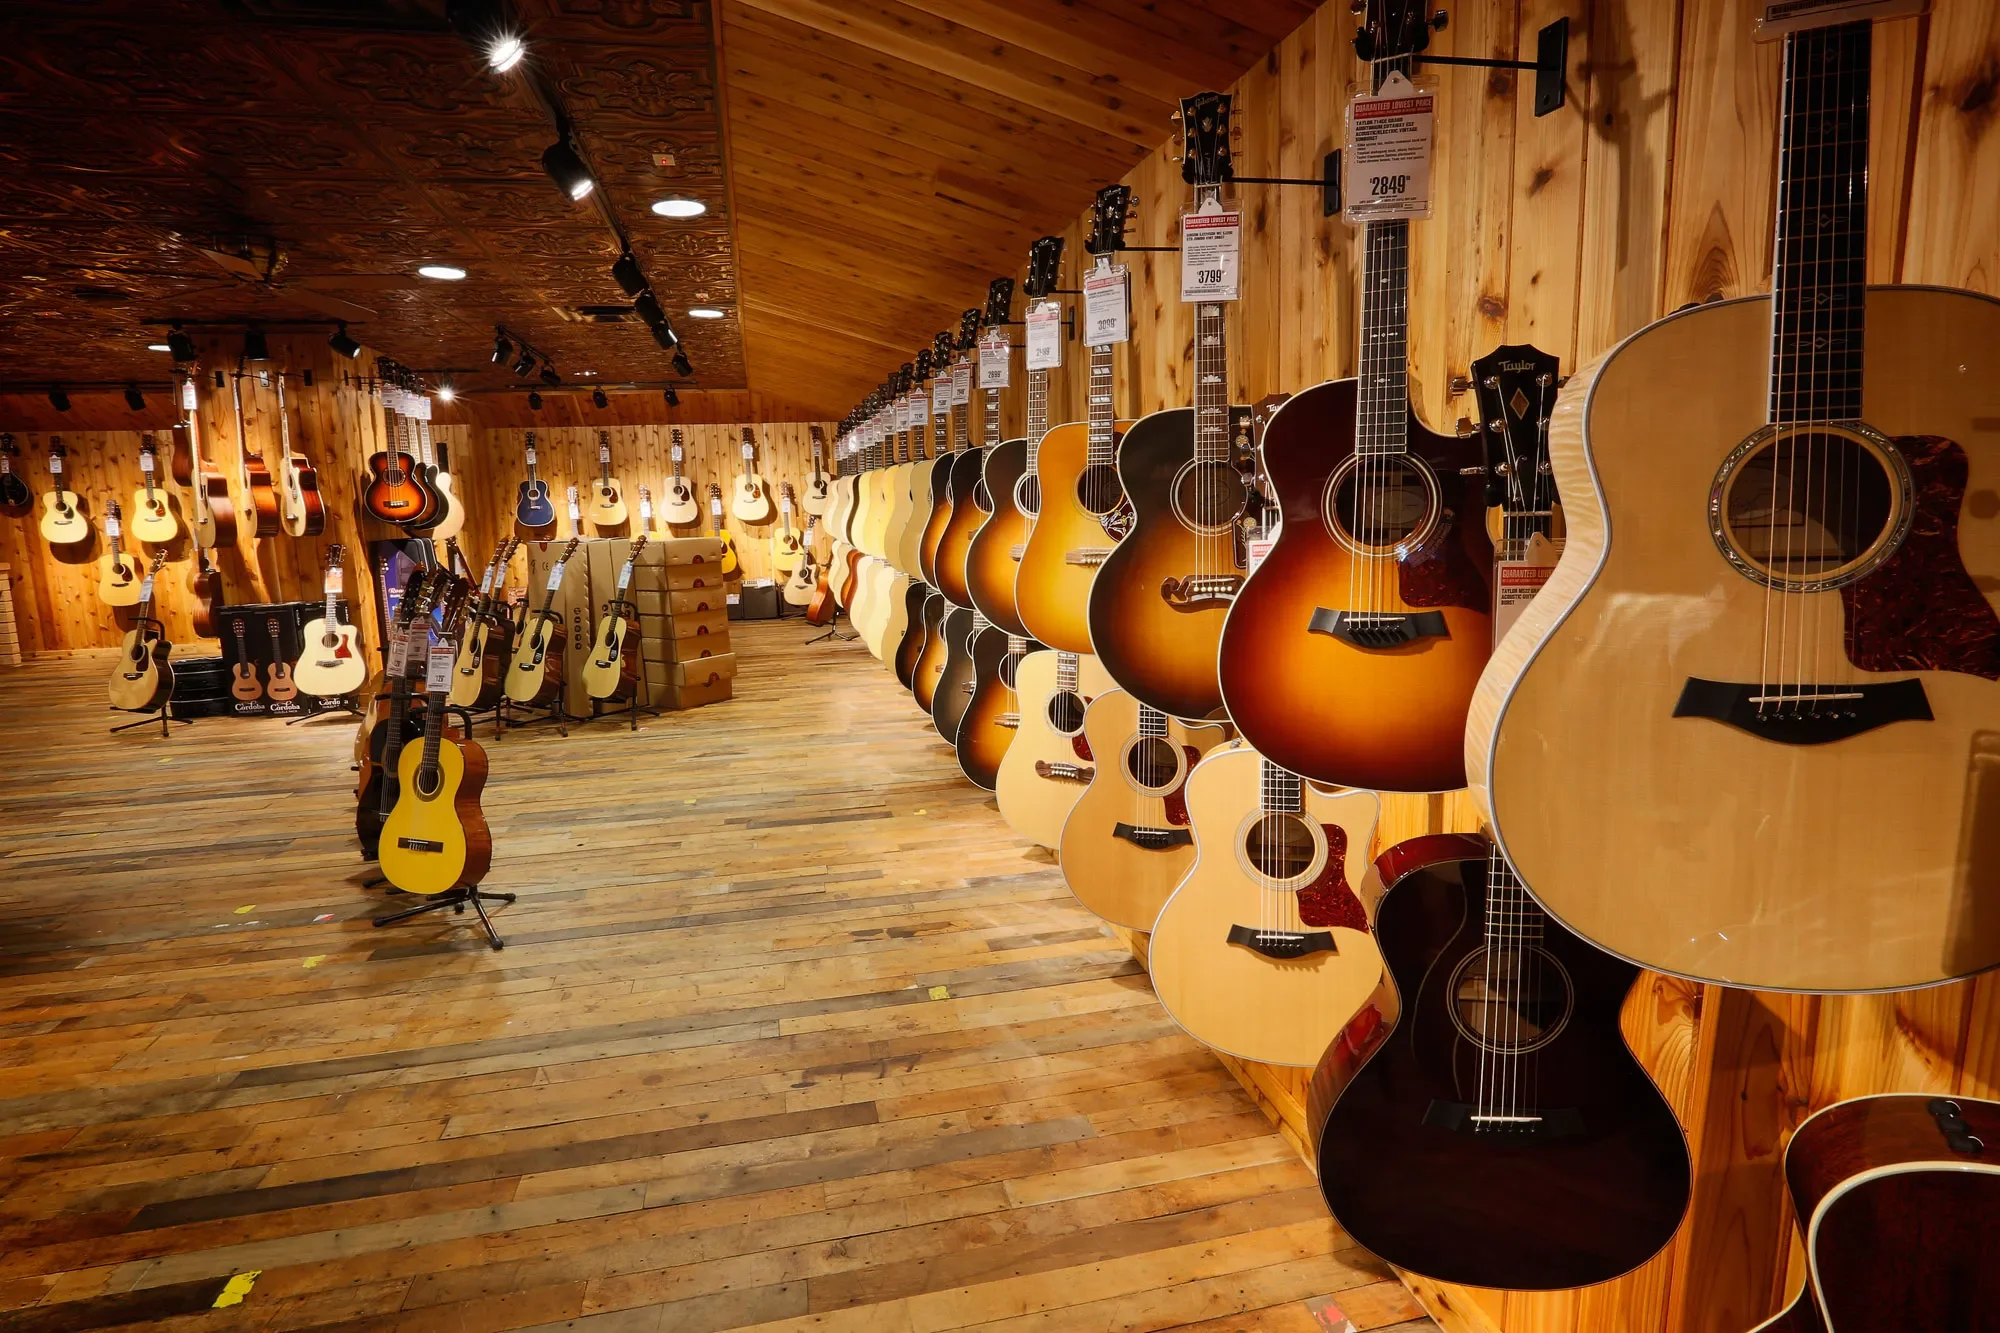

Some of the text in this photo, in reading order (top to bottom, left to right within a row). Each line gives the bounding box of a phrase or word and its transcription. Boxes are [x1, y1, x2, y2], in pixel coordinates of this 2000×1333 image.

[1355, 102, 1391, 113] GUARANTEED
[1392, 100, 1414, 110] LOWEST
[1415, 98, 1432, 107] PRICE
[1498, 360, 1536, 374] Taylor
[1502, 569, 1536, 578] GUARANTEED
